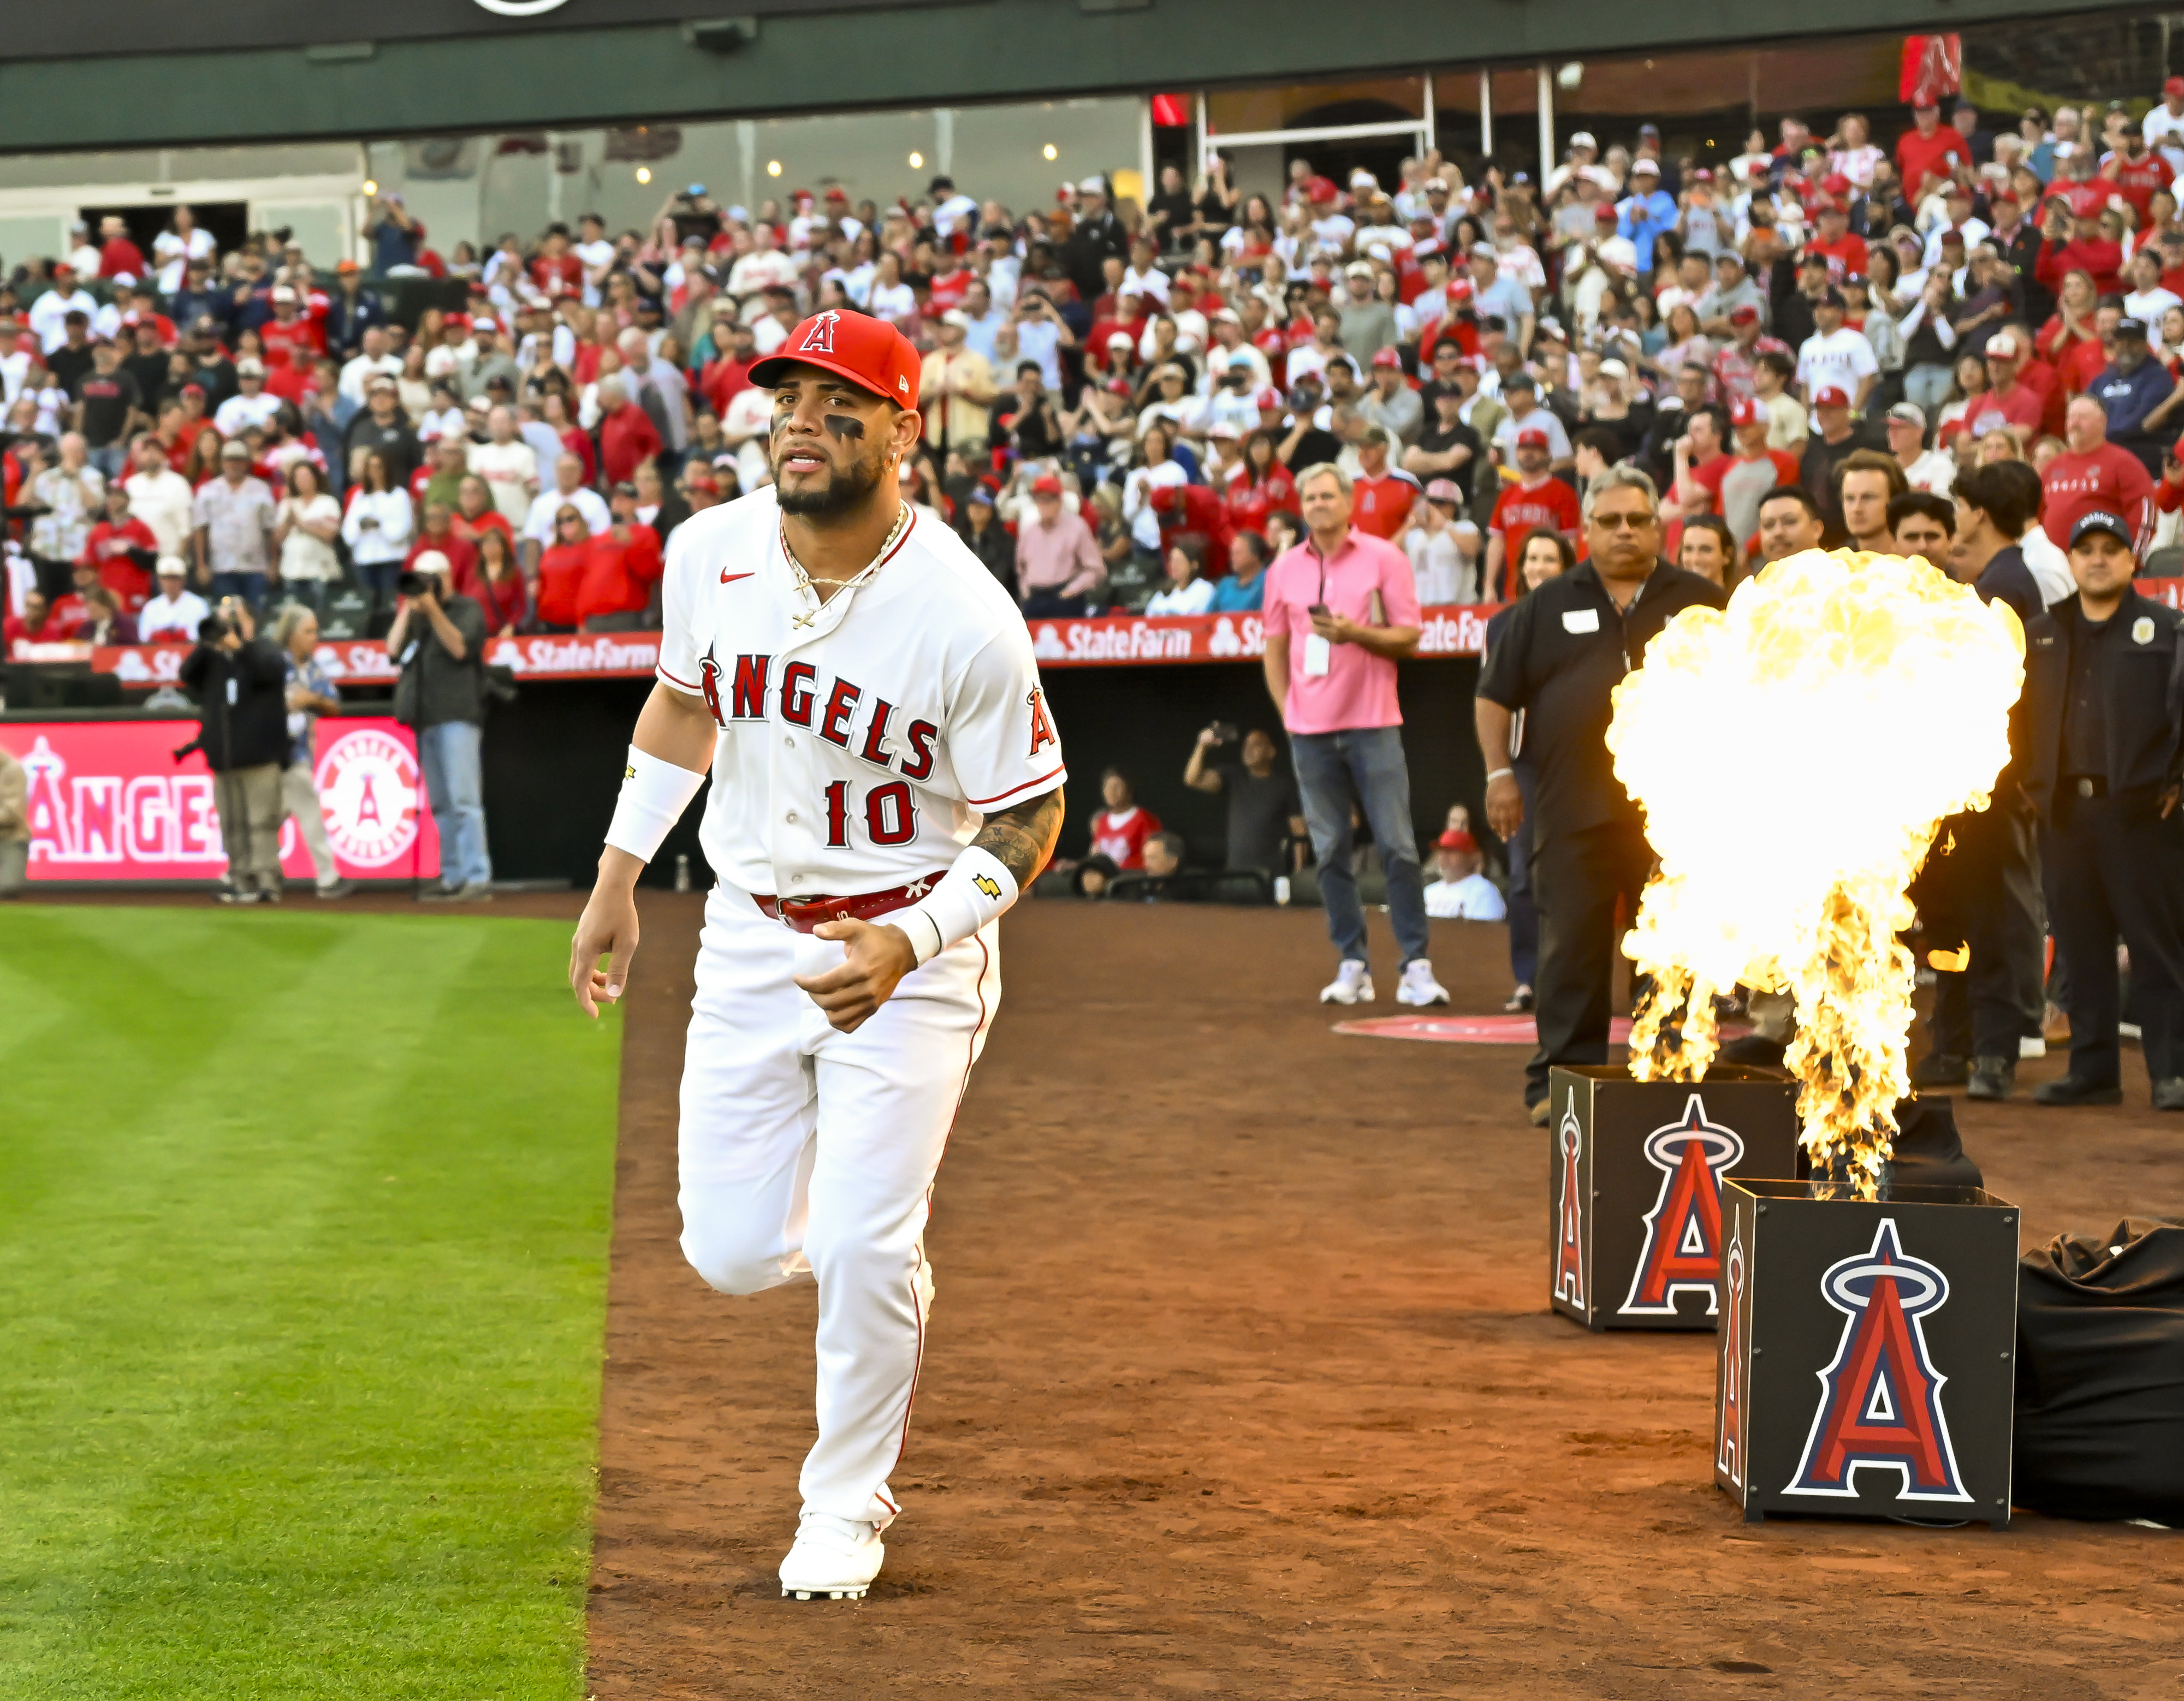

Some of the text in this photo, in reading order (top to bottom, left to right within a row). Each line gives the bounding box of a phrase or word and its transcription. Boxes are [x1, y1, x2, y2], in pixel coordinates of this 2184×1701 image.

[799, 310, 840, 353] A
[699, 635, 941, 783] ANGELS
[1026, 682, 1056, 757] A
[21, 735, 295, 862] ANGE
[823, 778, 921, 850] 10
[1554, 1085, 1585, 1310] A
[1617, 1093, 1744, 1315] A
[1718, 1203, 1745, 1488] A
[1780, 1218, 1975, 1503] A
